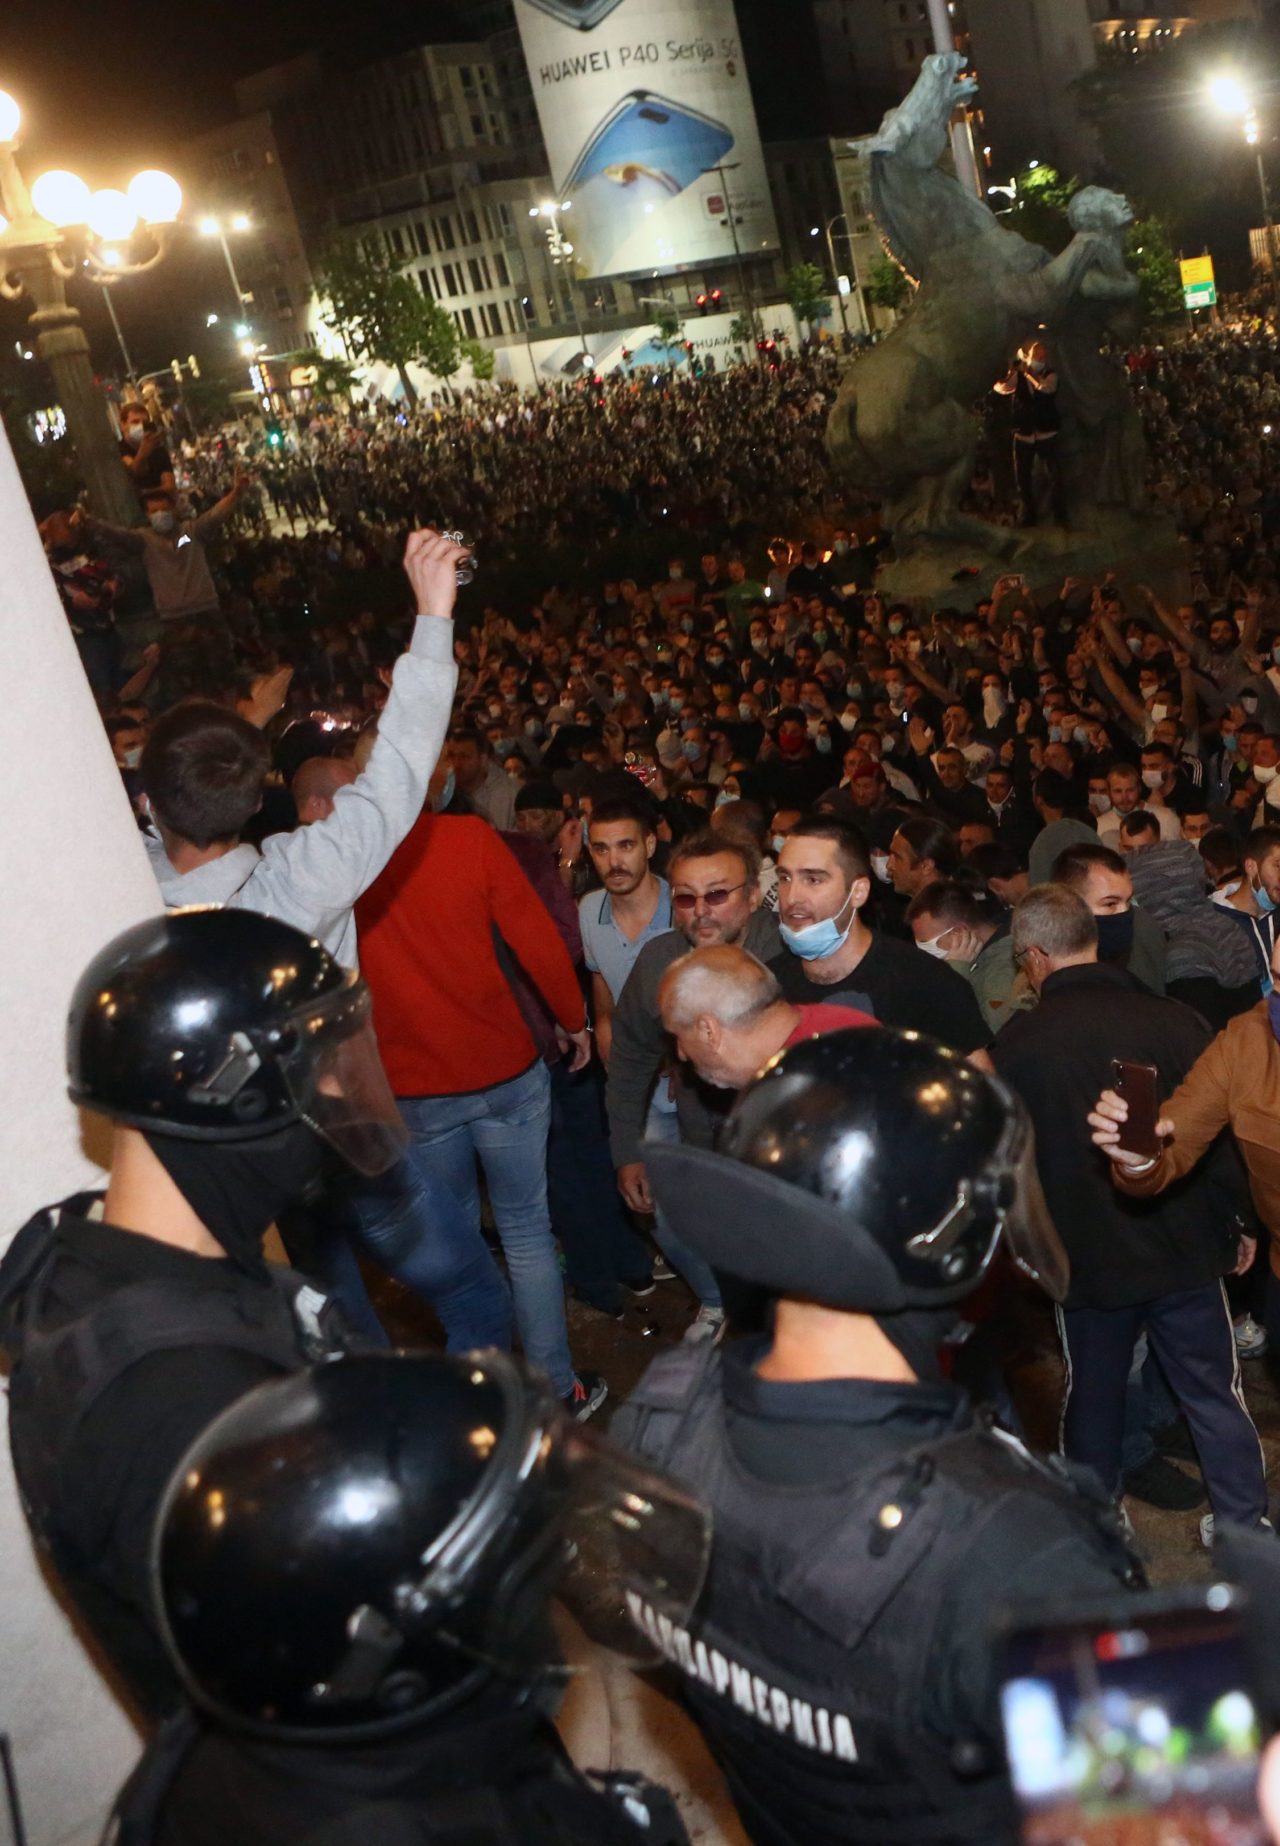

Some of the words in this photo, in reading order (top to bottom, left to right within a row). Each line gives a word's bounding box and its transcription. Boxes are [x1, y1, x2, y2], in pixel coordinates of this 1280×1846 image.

[540, 52, 610, 85] HUAWEI
[620, 43, 659, 67] P40
[666, 38, 714, 63] Serija
